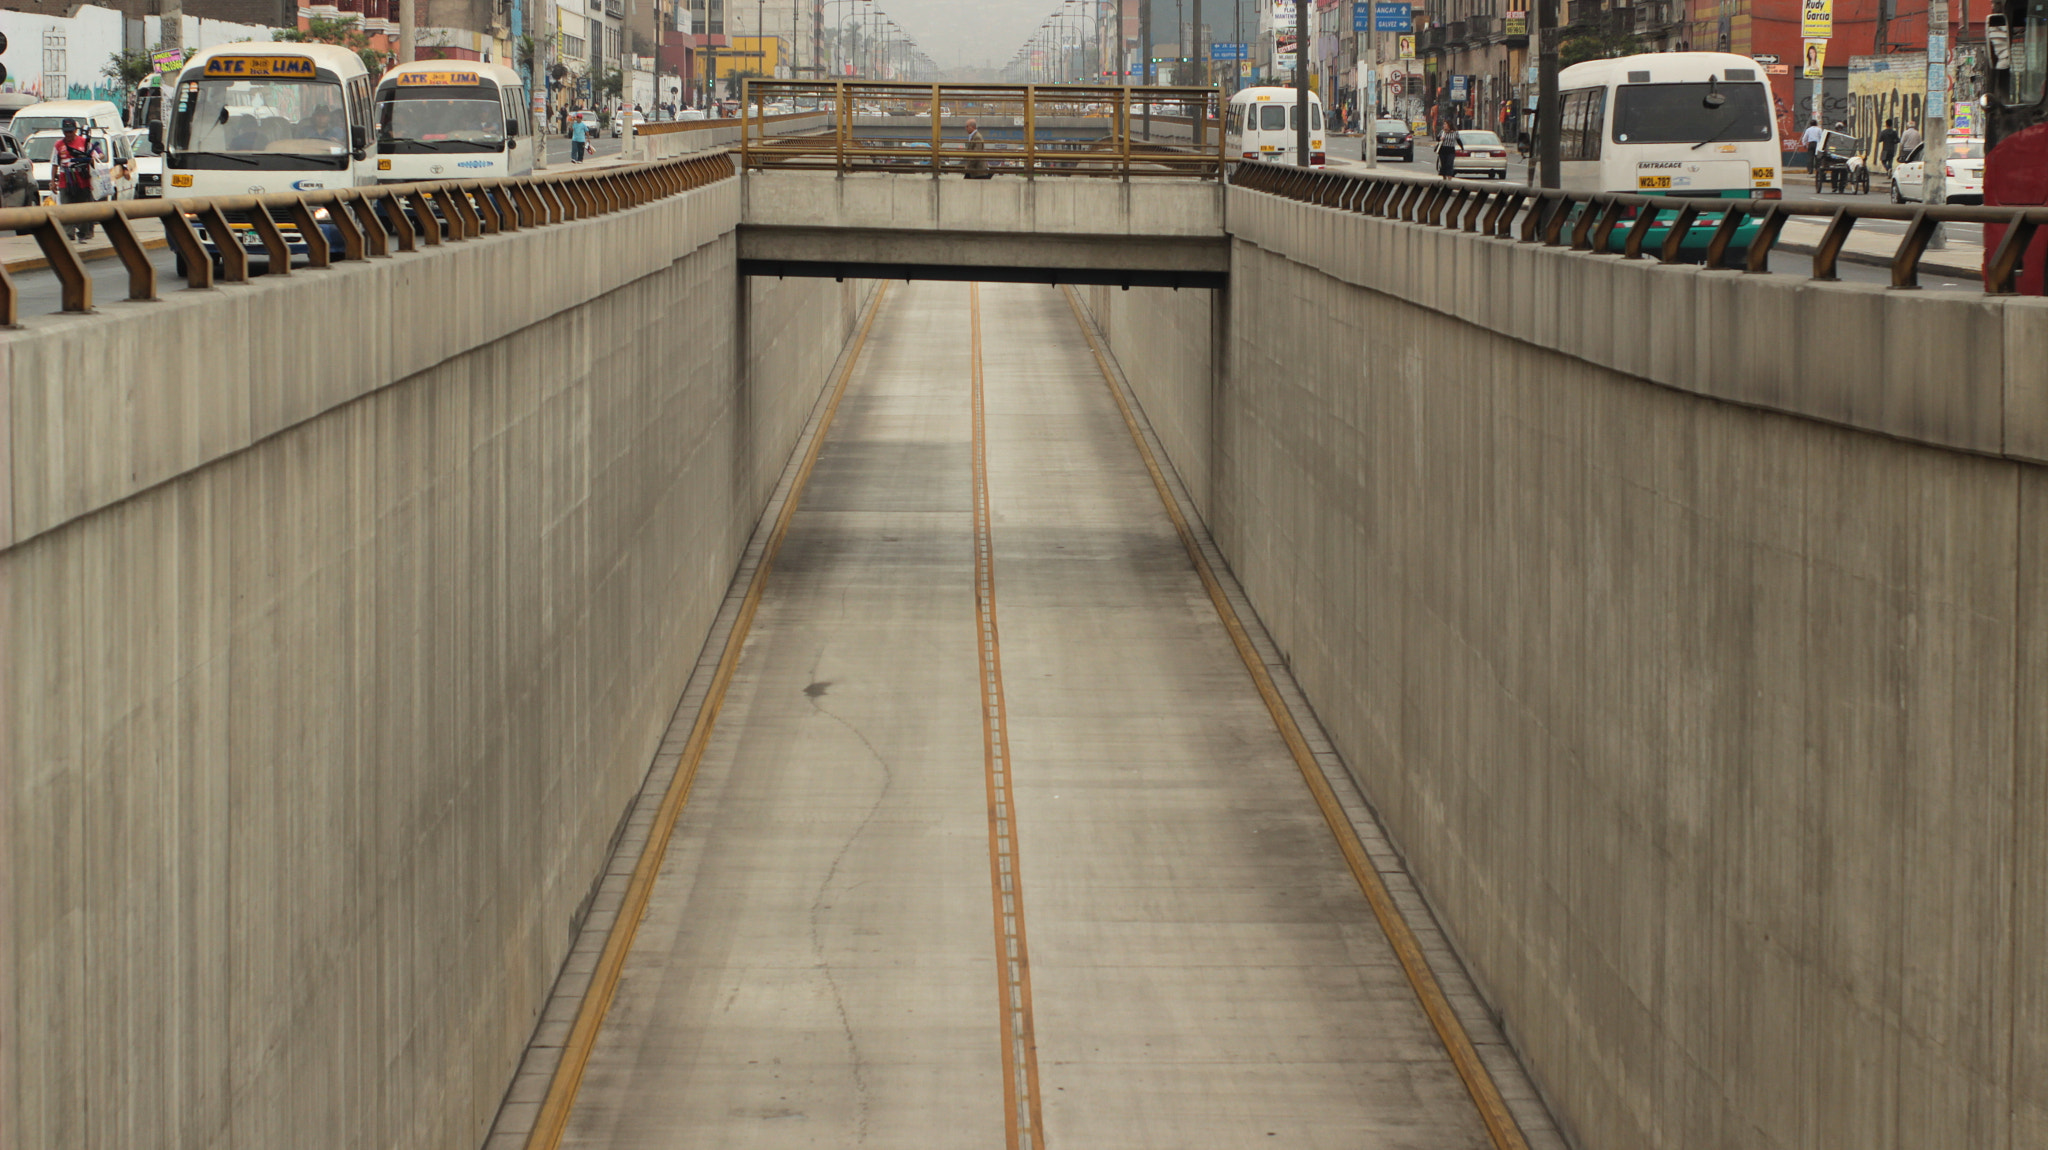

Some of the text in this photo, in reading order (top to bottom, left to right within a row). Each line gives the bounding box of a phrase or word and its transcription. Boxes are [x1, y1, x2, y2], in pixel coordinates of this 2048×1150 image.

[1805, 0, 1825, 10] Rudy
[207, 59, 313, 73] ATE LIMA
[402, 74, 427, 83] ATE
[451, 74, 477, 83] LIMA
[1752, 168, 1774, 179] NO-26
[1640, 176, 1671, 187] W2L-787
